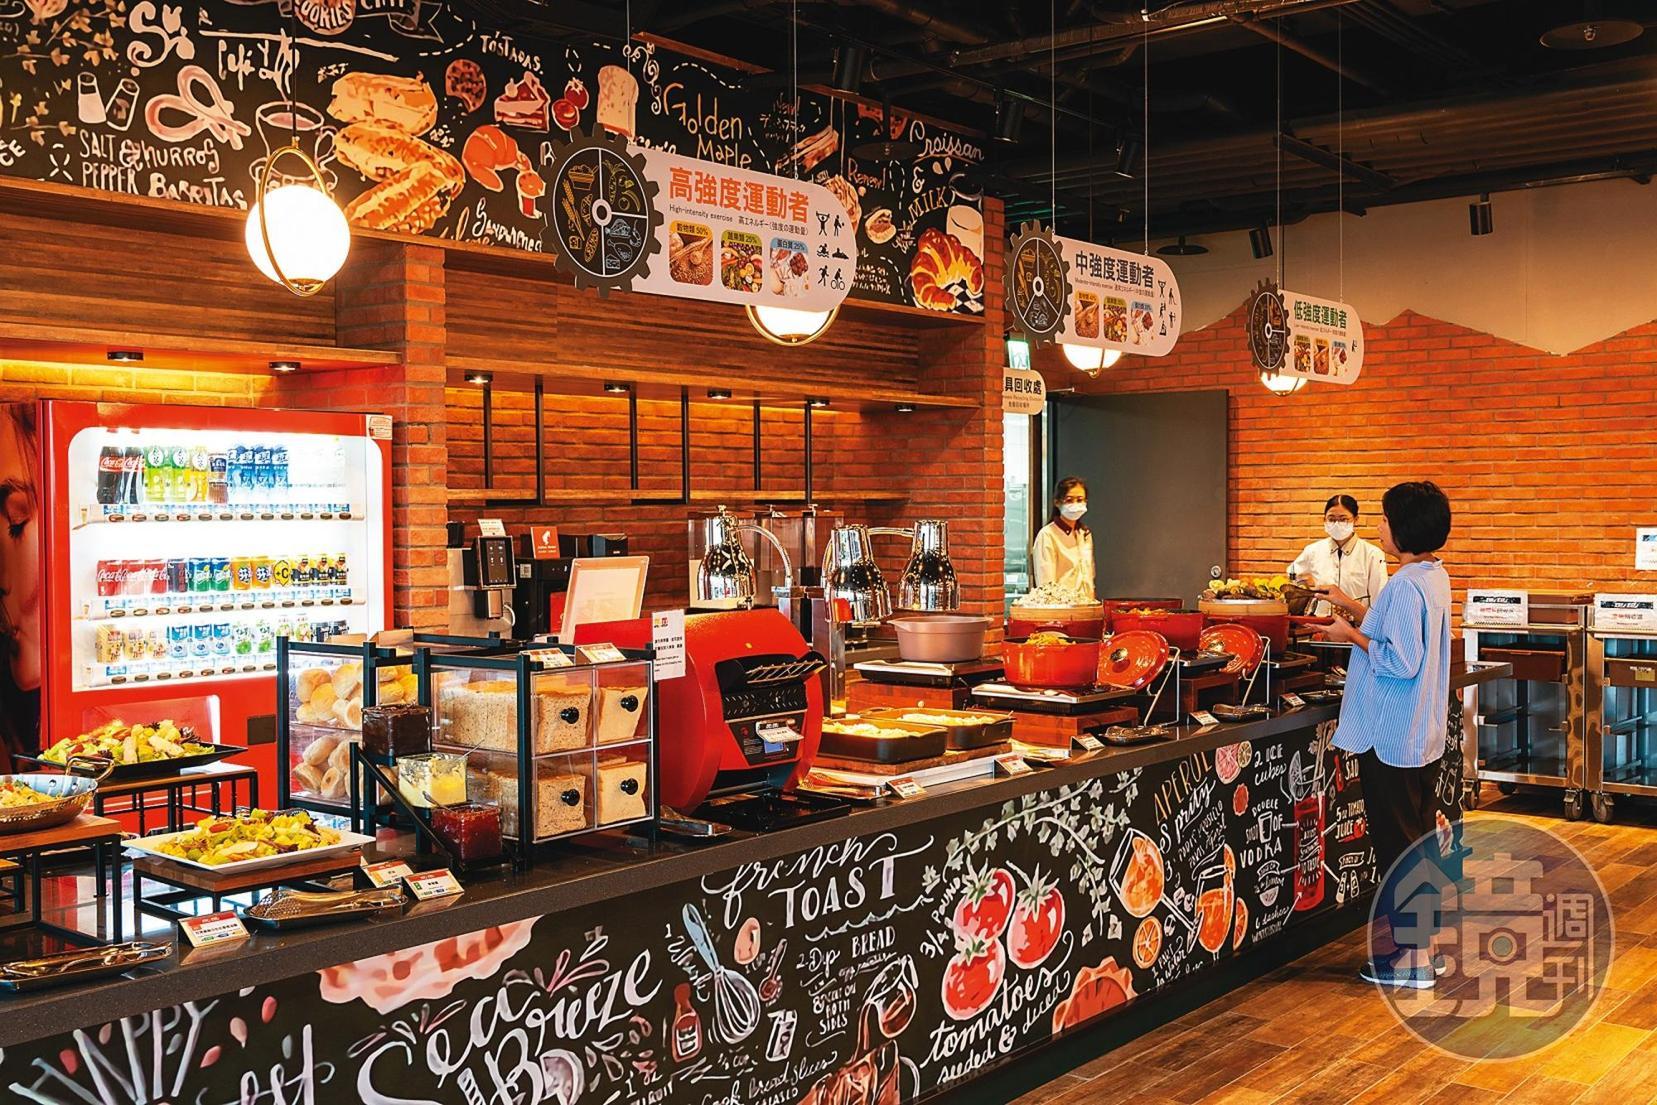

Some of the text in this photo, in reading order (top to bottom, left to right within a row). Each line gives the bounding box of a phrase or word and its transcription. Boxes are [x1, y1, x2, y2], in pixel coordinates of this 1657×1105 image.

[663, 82, 743, 141] Golden
[79, 128, 117, 162] SALT
[668, 166, 811, 224] 高強度運動者
[907, 185, 950, 226] MILK
[1074, 250, 1156, 290] 中強度運動者
[1293, 300, 1348, 329] 低強度運動者
[1254, 743, 1283, 768] 2 ICE
[1272, 813, 1284, 832] OF
[1334, 820, 1354, 840] JUICE
[1239, 836, 1283, 869] VODKA
[767, 834, 935, 929] TOAST
[851, 925, 896, 958] BREAD
[819, 1013, 849, 1035] SIDES
[936, 1047, 996, 1086] seeded
